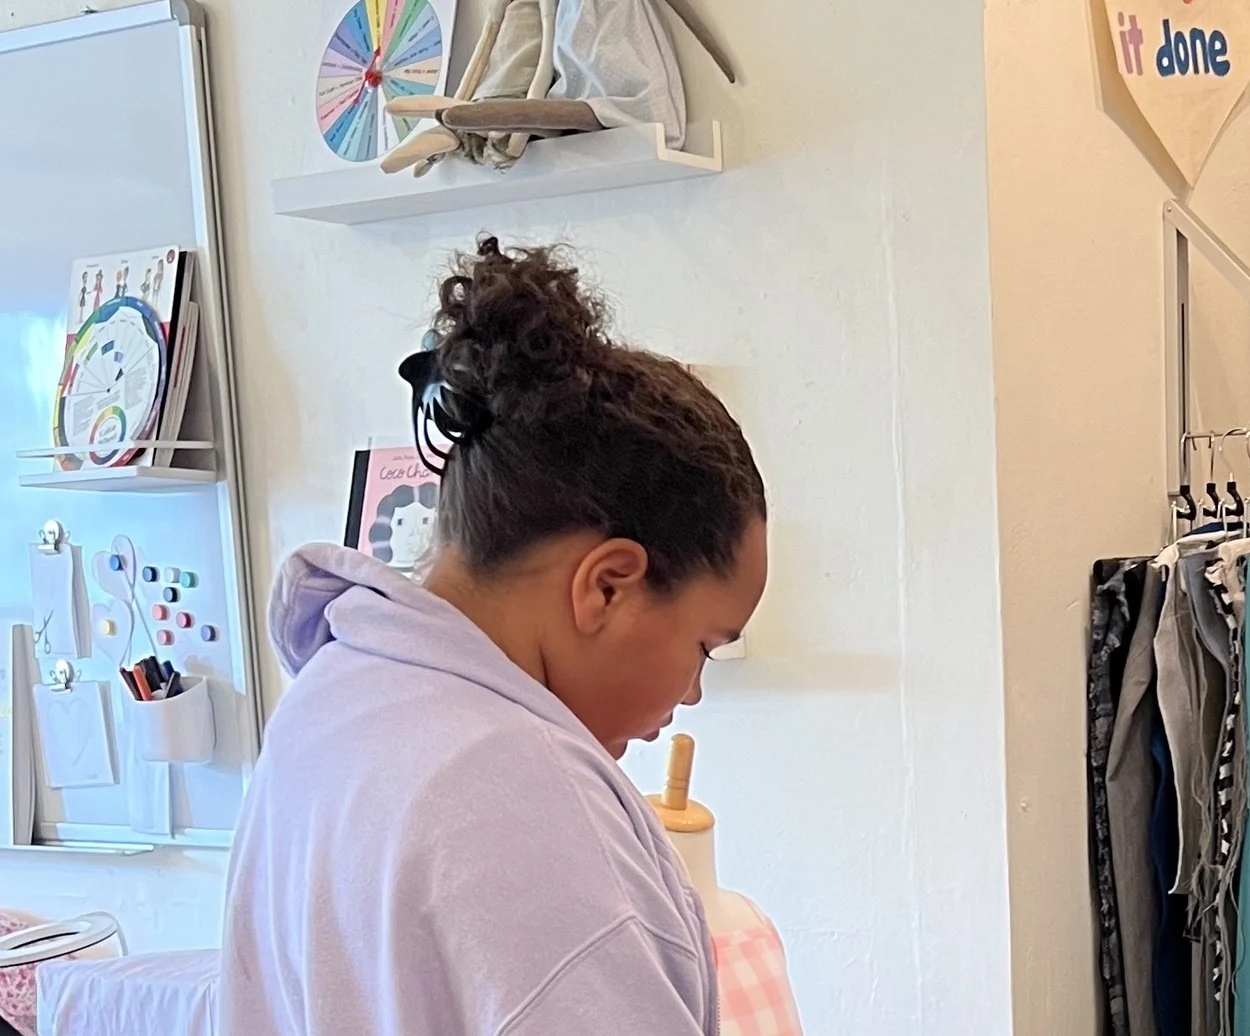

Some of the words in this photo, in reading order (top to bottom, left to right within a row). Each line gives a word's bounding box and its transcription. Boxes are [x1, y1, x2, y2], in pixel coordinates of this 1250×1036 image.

[1117, 11, 1144, 76] it
[1156, 18, 1231, 77] done
[379, 465, 405, 480] Coco
